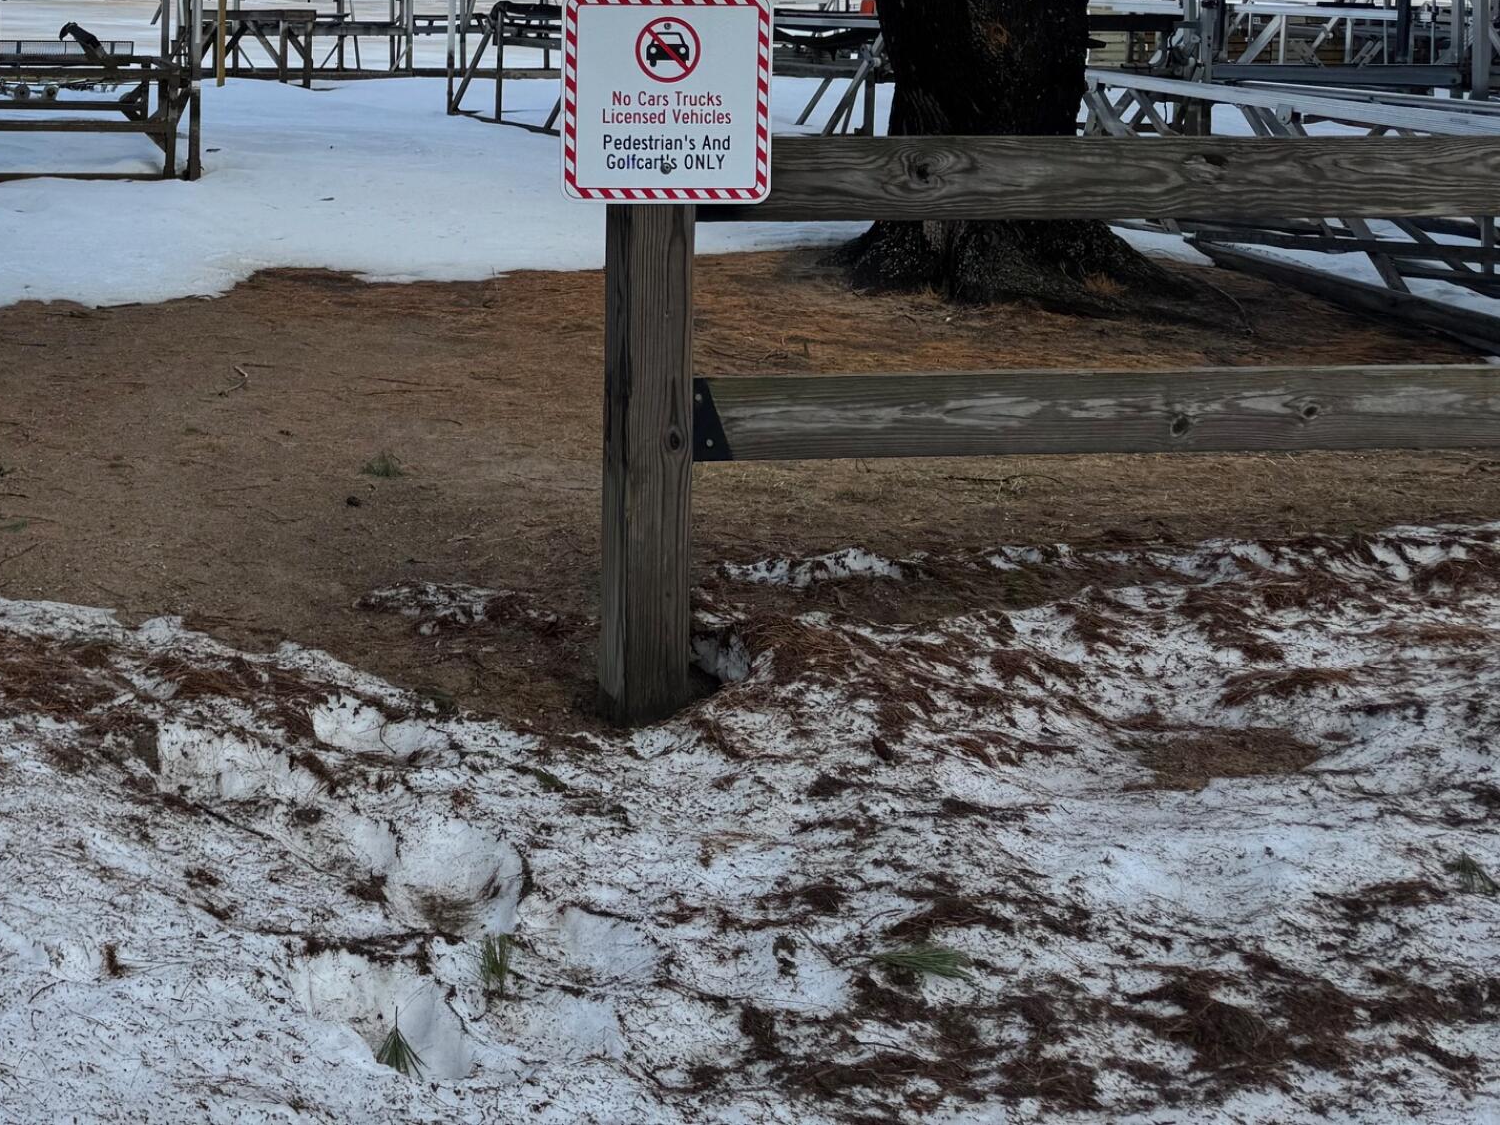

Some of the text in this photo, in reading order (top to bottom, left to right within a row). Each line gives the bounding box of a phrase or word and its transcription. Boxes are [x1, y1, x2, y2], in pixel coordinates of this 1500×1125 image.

[612, 91, 722, 106] No Cars Trucks
[602, 109, 732, 124] Licensed Vehicles
[603, 134, 731, 150] Pedestrian's And
[606, 154, 725, 170] Golfcart's ONLY
